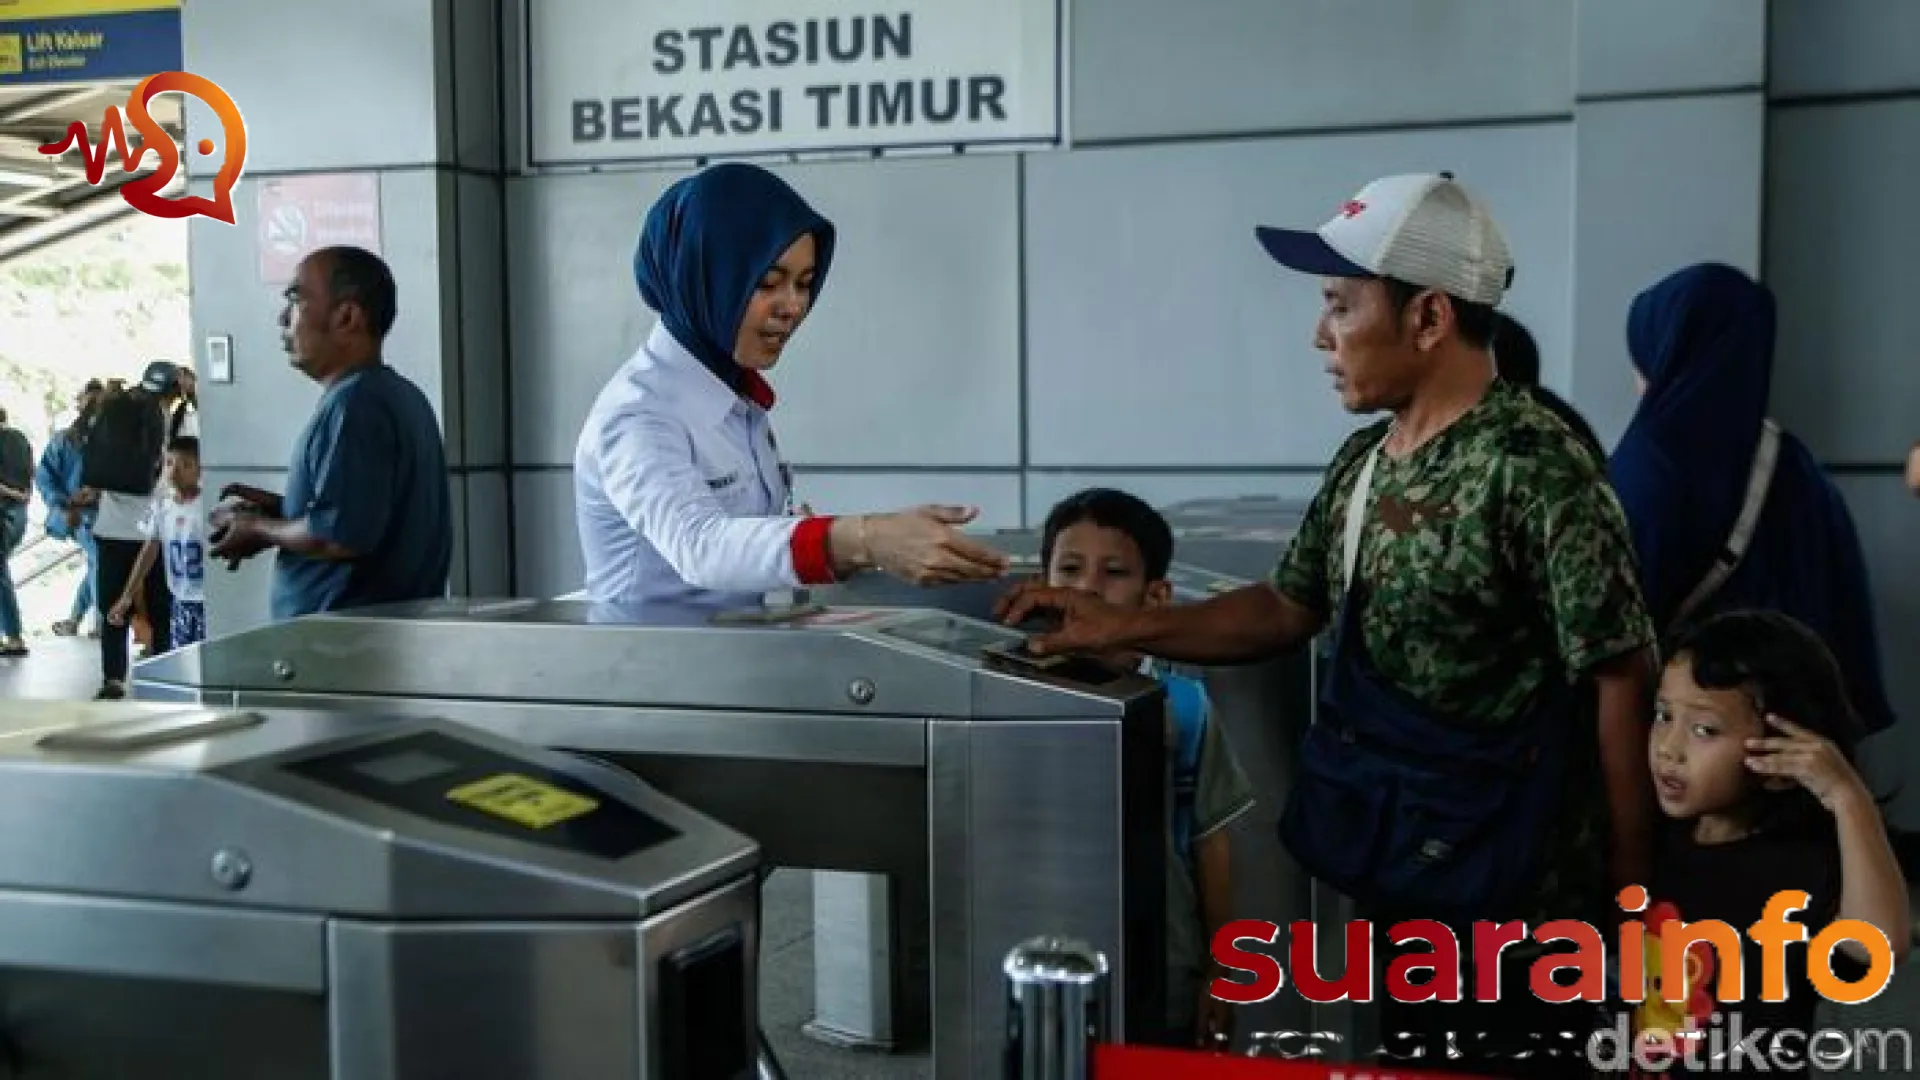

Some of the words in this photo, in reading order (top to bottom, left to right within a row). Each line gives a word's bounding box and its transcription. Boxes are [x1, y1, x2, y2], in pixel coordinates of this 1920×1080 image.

[652, 13, 913, 75] STASIUN
[572, 88, 783, 143] BEKASI
[806, 75, 1008, 130] TIMUR
